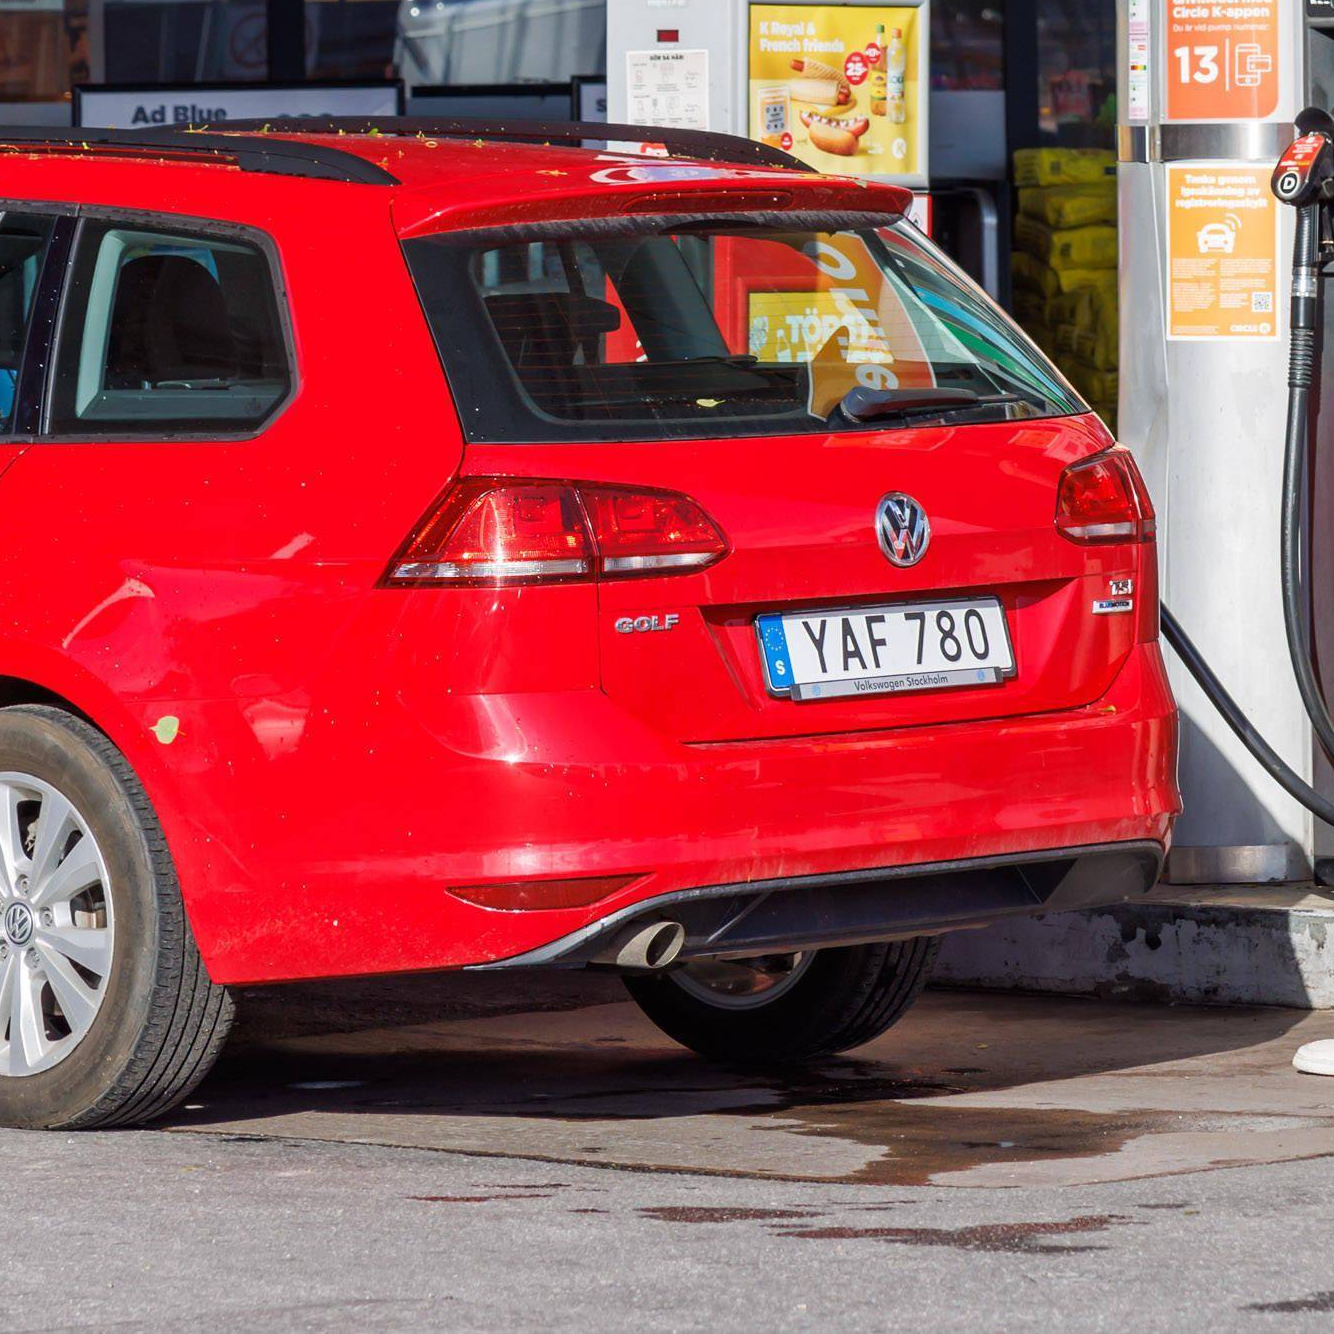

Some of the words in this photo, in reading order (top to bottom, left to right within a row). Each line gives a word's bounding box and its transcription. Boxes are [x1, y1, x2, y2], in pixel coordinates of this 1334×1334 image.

[1173, 6, 1209, 18] Circle
[1212, 6, 1270, 19] K-appen
[759, 22, 768, 35] K
[771, 21, 804, 37] Royal
[759, 39, 800, 52] French
[1173, 45, 1219, 84] 13
[131, 104, 169, 124] Ad
[174, 104, 227, 123] Blue
[1184, 174, 1215, 184] Tanka
[1218, 175, 1256, 185] genom
[1283, 177, 1296, 189] D
[615, 613, 679, 633] GOLF
[802, 615, 887, 674] YAF
[904, 609, 990, 666] 780
[775, 660, 785, 675] S
[854, 675, 905, 692] Volkswagen
[907, 674, 949, 687] Stockholm
